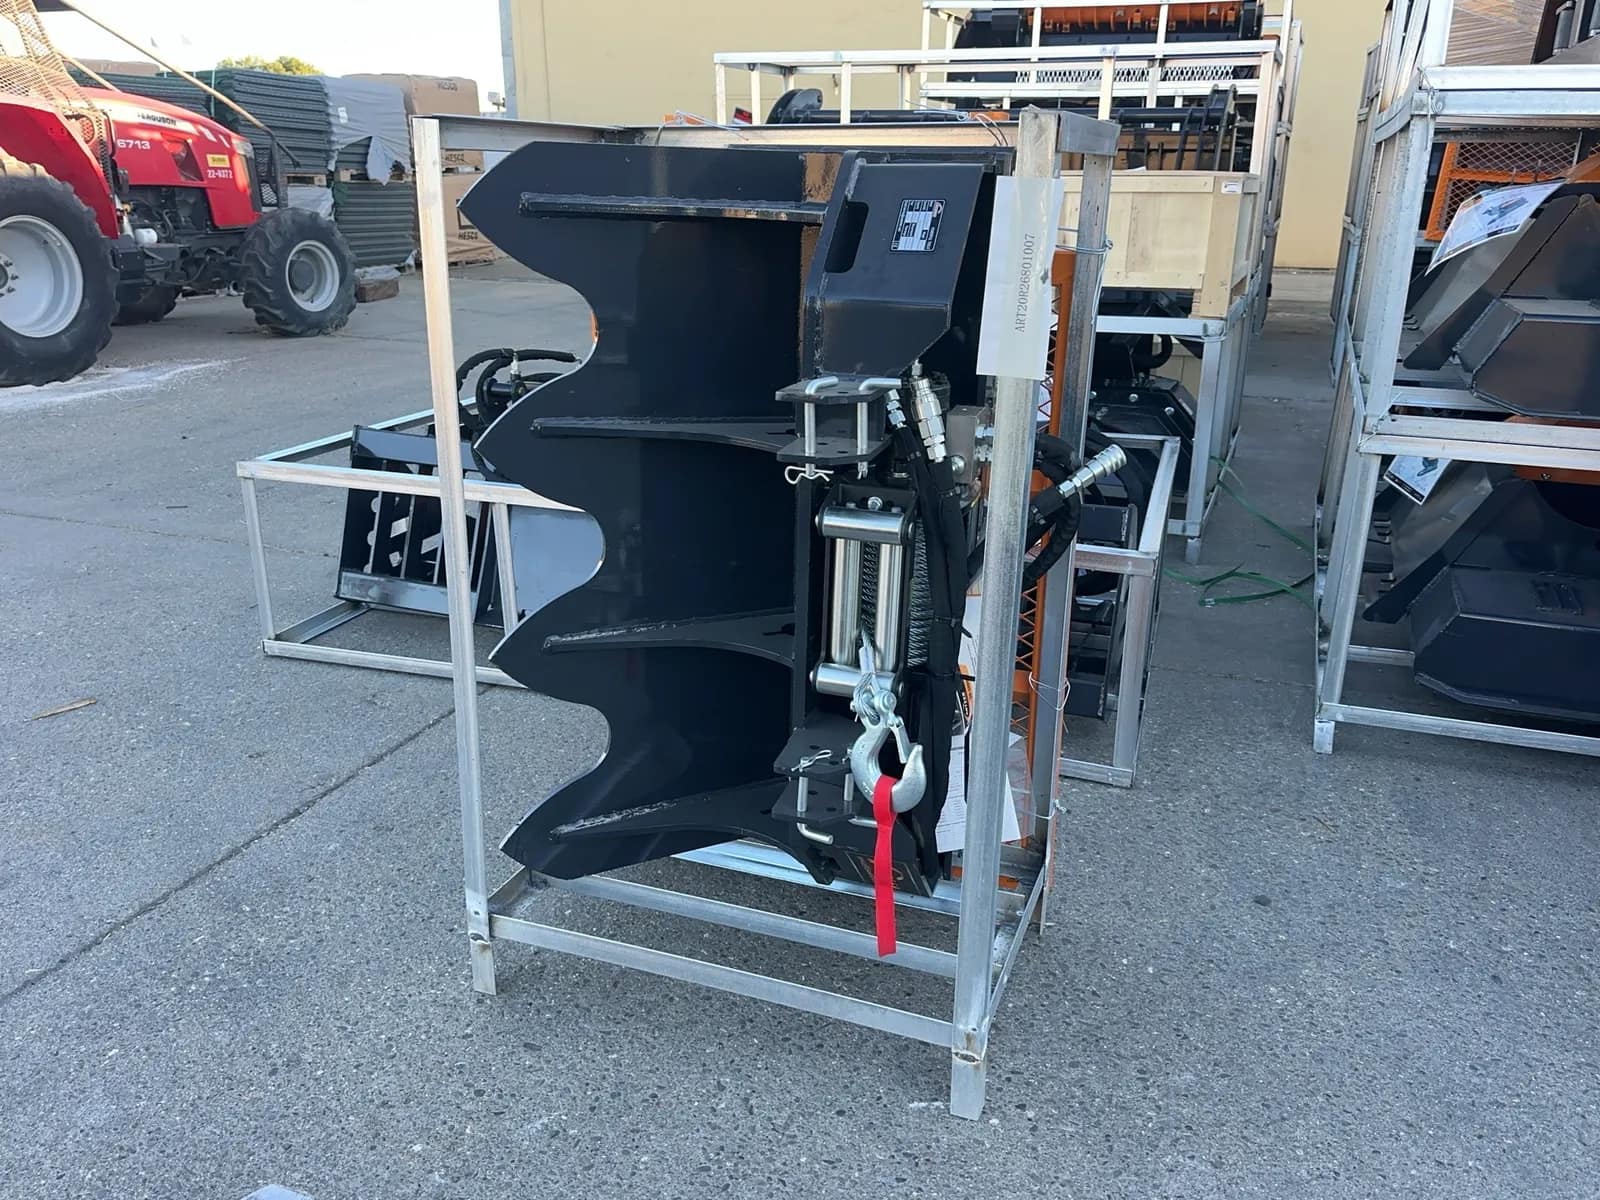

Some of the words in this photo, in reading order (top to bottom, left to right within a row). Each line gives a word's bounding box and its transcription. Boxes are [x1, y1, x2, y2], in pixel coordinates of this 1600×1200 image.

[116, 139, 152, 150] 6713
[458, 231, 478, 241] HESCO
[1014, 232, 1036, 334] ART20R26801007
